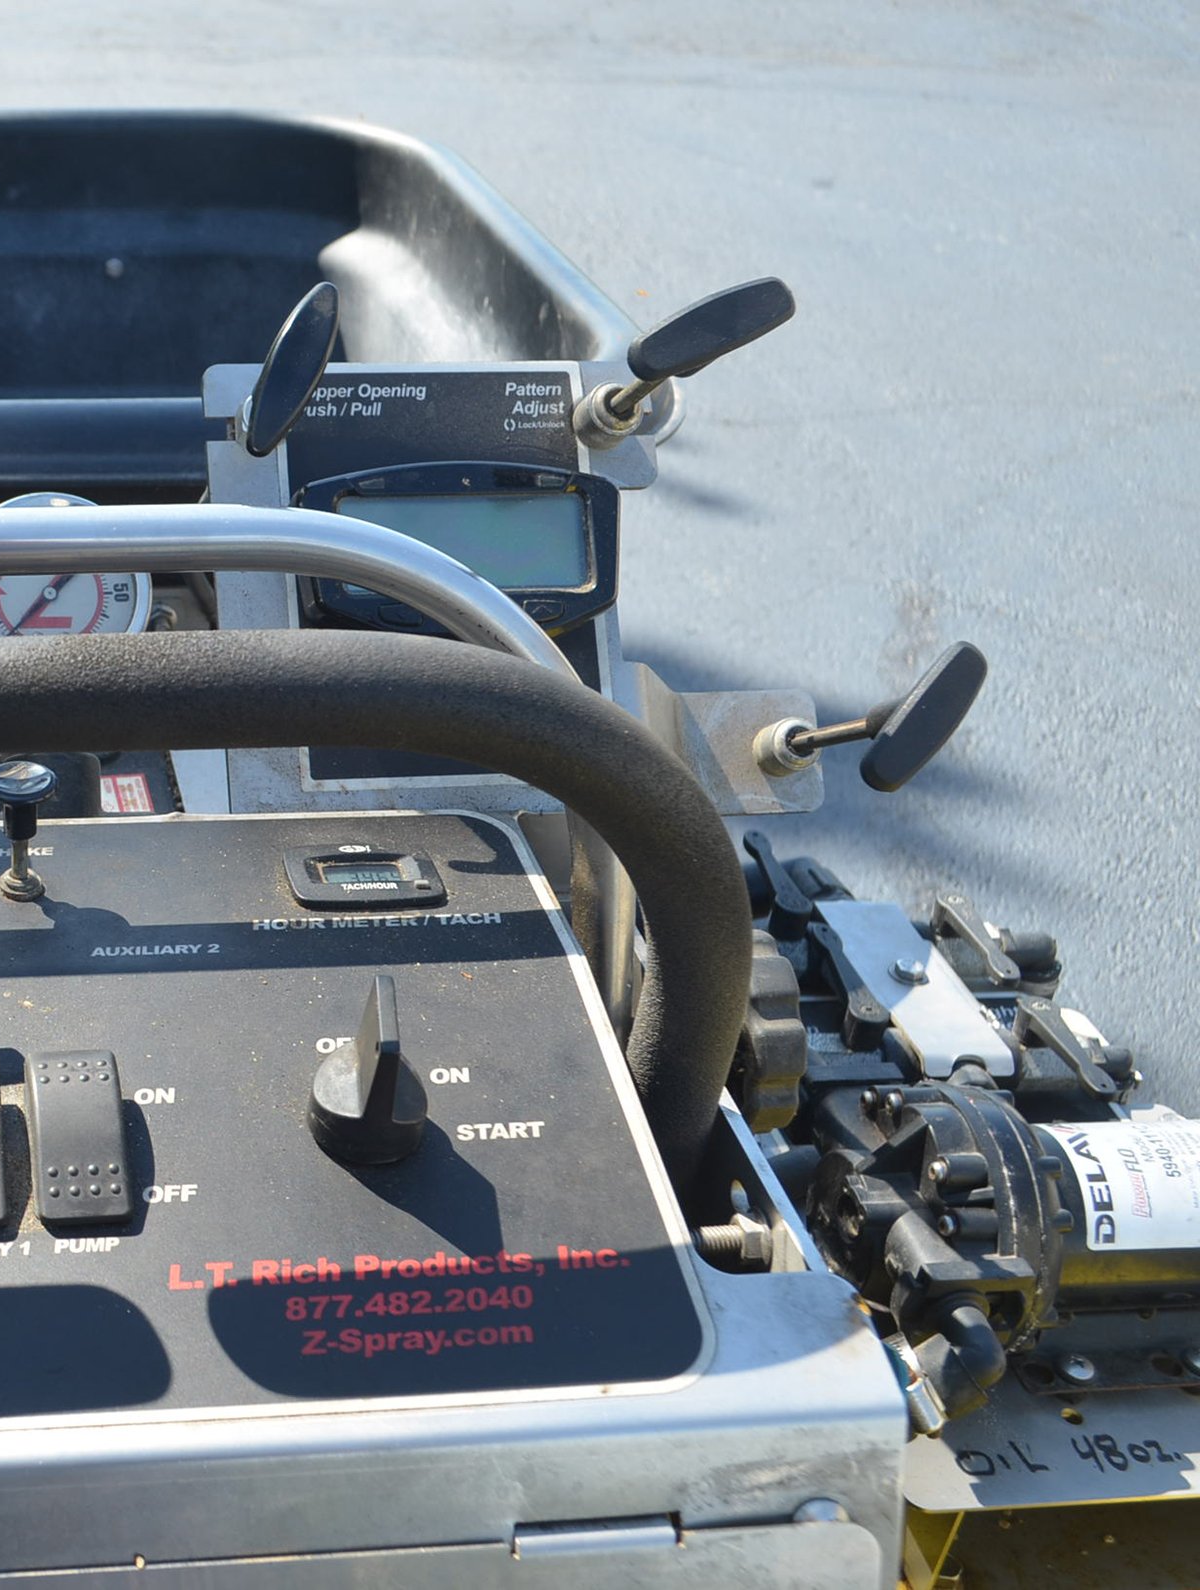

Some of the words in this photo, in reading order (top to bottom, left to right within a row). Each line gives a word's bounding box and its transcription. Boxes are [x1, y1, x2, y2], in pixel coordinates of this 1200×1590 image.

[312, 387, 354, 402] pper
[358, 383, 426, 401] Opening
[505, 383, 562, 397] Pattern
[304, 402, 338, 417] ush
[340, 402, 348, 417] /
[350, 402, 382, 417] Pull
[511, 400, 565, 418] Adjust
[518, 420, 565, 429] Lock/Unlock
[113, 583, 131, 603] 50
[340, 881, 399, 891] TACH/HOUR
[252, 917, 327, 931] HOUR
[332, 915, 418, 929] METER
[424, 914, 432, 926] /
[438, 912, 502, 925] TACH
[90, 944, 202, 957] AUXILIARY
[207, 944, 221, 954] 2
[315, 1036, 356, 1054] OF
[429, 1067, 470, 1085] ON
[133, 1087, 176, 1104] ON
[456, 1120, 545, 1141] START
[141, 1183, 198, 1204] OFF
[18, 1241, 32, 1256] 1
[54, 1237, 120, 1254] PUMP
[167, 1261, 238, 1290] L.T.
[252, 1256, 341, 1286] Rich
[354, 1248, 546, 1281] Products,
[556, 1244, 631, 1270] Inc.
[284, 1285, 534, 1321] 877.482.2040
[301, 1324, 535, 1358] Z-Spray.com
[955, 1439, 1050, 1477] OIL
